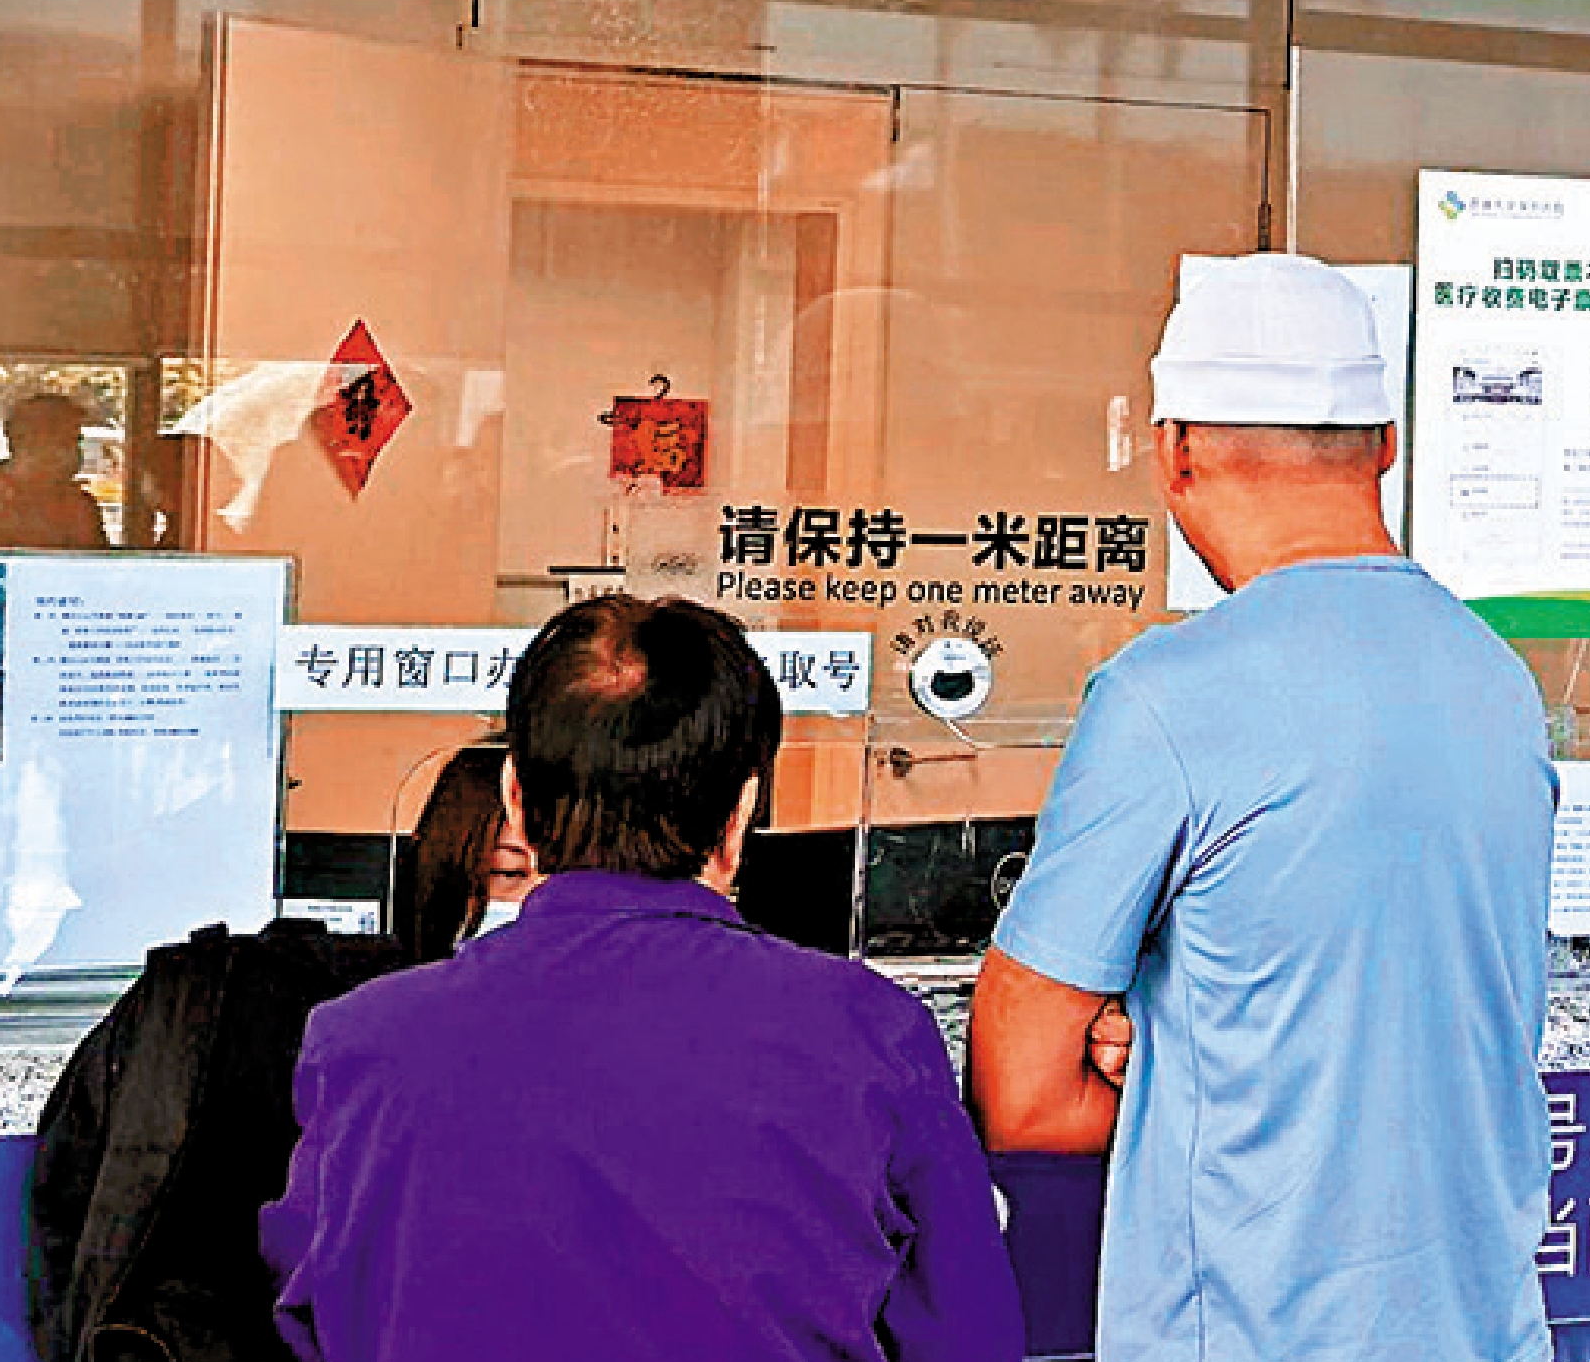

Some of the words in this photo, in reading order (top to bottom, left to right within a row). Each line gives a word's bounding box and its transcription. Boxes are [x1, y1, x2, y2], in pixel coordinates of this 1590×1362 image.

[717, 505, 1148, 573] 请保持一米距离
[716, 571, 816, 602] Please
[826, 574, 896, 610] keep
[908, 580, 962, 604] one
[974, 579, 1059, 604] meter
[1070, 584, 1145, 613] away
[762, 650, 861, 691] 取号
